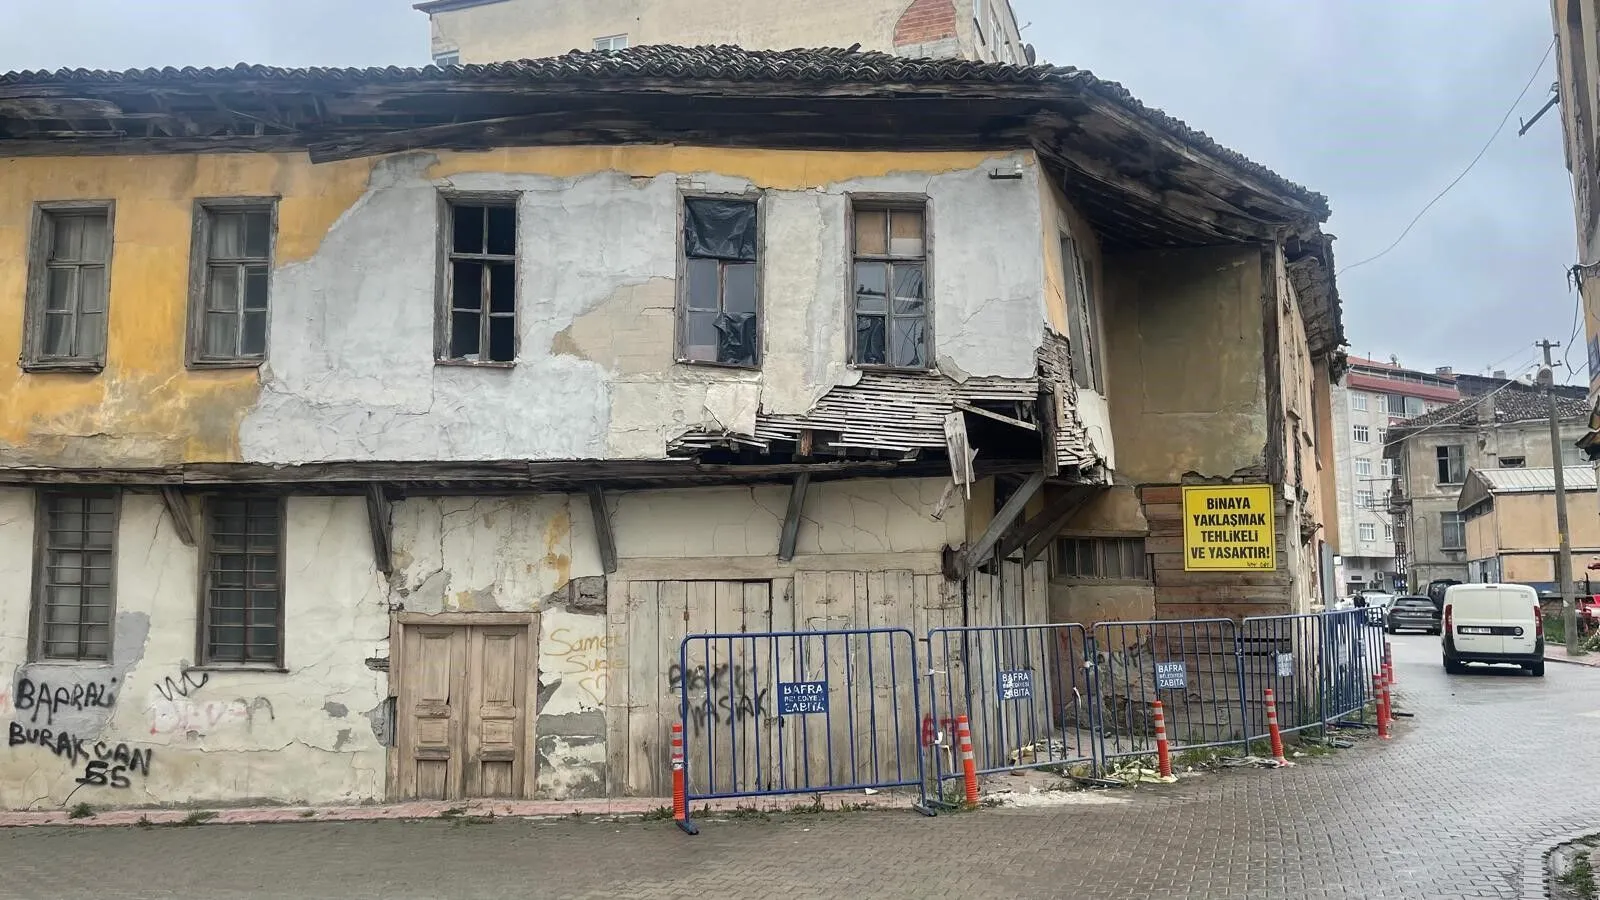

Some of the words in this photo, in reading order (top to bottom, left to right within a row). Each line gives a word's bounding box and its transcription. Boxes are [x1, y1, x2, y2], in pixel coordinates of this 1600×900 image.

[1193, 513, 1266, 527] YAKLAŞMAK
[1191, 547, 1205, 559] VE
[1208, 546, 1270, 559] YASAKTIR!
[1159, 664, 1183, 673] BAFRA
[1002, 672, 1029, 682] BAFRA
[1160, 679, 1184, 687] ZABITA
[784, 684, 824, 694] BAFRA
[1003, 688, 1030, 699] ZABITA
[785, 702, 825, 712] ZABITA
[9, 721, 90, 768] BURAK
